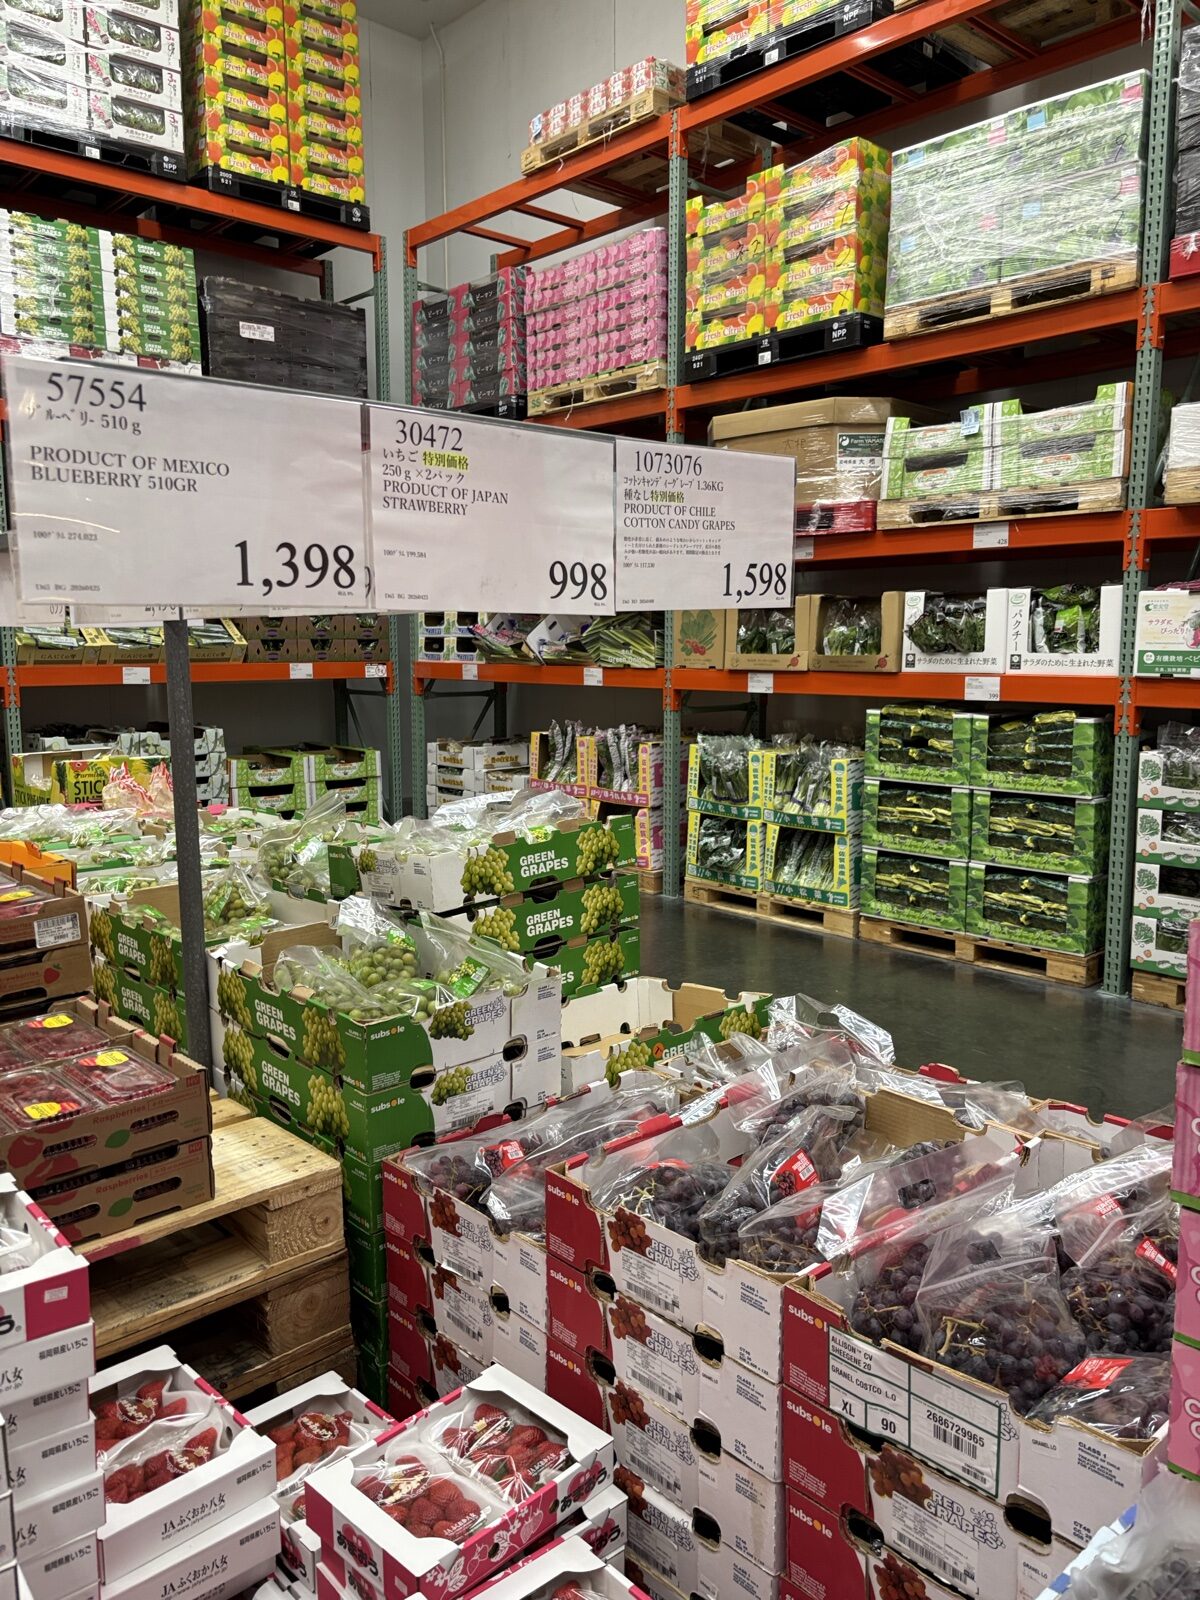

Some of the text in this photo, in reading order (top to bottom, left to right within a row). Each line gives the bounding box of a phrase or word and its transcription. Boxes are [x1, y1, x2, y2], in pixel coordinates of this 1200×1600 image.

[843, 8, 858, 22] NPP
[785, 307, 805, 322] Fresh
[832, 328, 847, 338] NPP
[47, 373, 147, 412] 57554
[101, 415, 127, 430] 510
[132, 422, 141, 435] g
[395, 420, 463, 451] 30472
[30, 445, 230, 477] PRODUCT OF MEXICO
[383, 448, 469, 470] いちご 特別価格
[635, 451, 702, 476] 1073076
[31, 466, 198, 492] BLUEBERRY 510GR
[382, 464, 401, 476] 250
[405, 470, 411, 481] g
[384, 480, 508, 504] PRODUCT OF JAPAN
[697, 481, 724, 491] 1.36KG
[383, 496, 468, 515] STRAWBERRY
[624, 503, 716, 517] PRODUCT OF CHILE
[624, 517, 735, 530] COTTON CANDY GRAPES
[235, 540, 356, 596] 1,398
[550, 560, 607, 601] 998
[723, 563, 787, 603] 1,598
[1011, 610, 1022, 652] パクチー
[916, 656, 998, 667] サラダのために生まれた野菜
[1023, 658, 1114, 668] サラダのために生まれた野菜
[520, 849, 555, 867] GREEN
[520, 859, 569, 878] GRAPES
[526, 909, 561, 926] GREEN
[526, 916, 573, 937] GRAPES
[117, 932, 138, 949] GREEN
[118, 942, 146, 965] GRAPES
[121, 986, 143, 1004] GREEN
[122, 998, 150, 1021] GRAPES
[254, 999, 284, 1021] GREEN
[464, 1009, 504, 1026] GRAPES
[256, 1012, 296, 1041] GRAPES
[261, 1061, 290, 1086] GREEN
[465, 1074, 505, 1092] GRAPES
[262, 1073, 301, 1107] GRAPES
[651, 1238, 674, 1256] RED
[645, 1246, 699, 1283] GRAPES
[788, 1303, 828, 1333] subsol
[651, 1329, 674, 1348] RED
[645, 1337, 698, 1375] GRAPES
[831, 1346, 872, 1371] SHEEGENE 20
[864, 1353, 873, 1362] CV
[831, 1365, 854, 1385] GRANEL
[855, 1377, 882, 1395] COSTCO
[841, 1400, 855, 1417] XL
[649, 1417, 671, 1438] RED
[881, 1418, 896, 1435] 90
[926, 1409, 985, 1448] 2686729965
[645, 1425, 694, 1466] GRAPES
[1078, 1442, 1102, 1455] CLASS
[161, 1492, 226, 1535] JA ふくおか八女
[931, 1489, 965, 1517] RED
[923, 1498, 999, 1550] GRAPES
[161, 1554, 228, 1598] JA ふくおか八女
